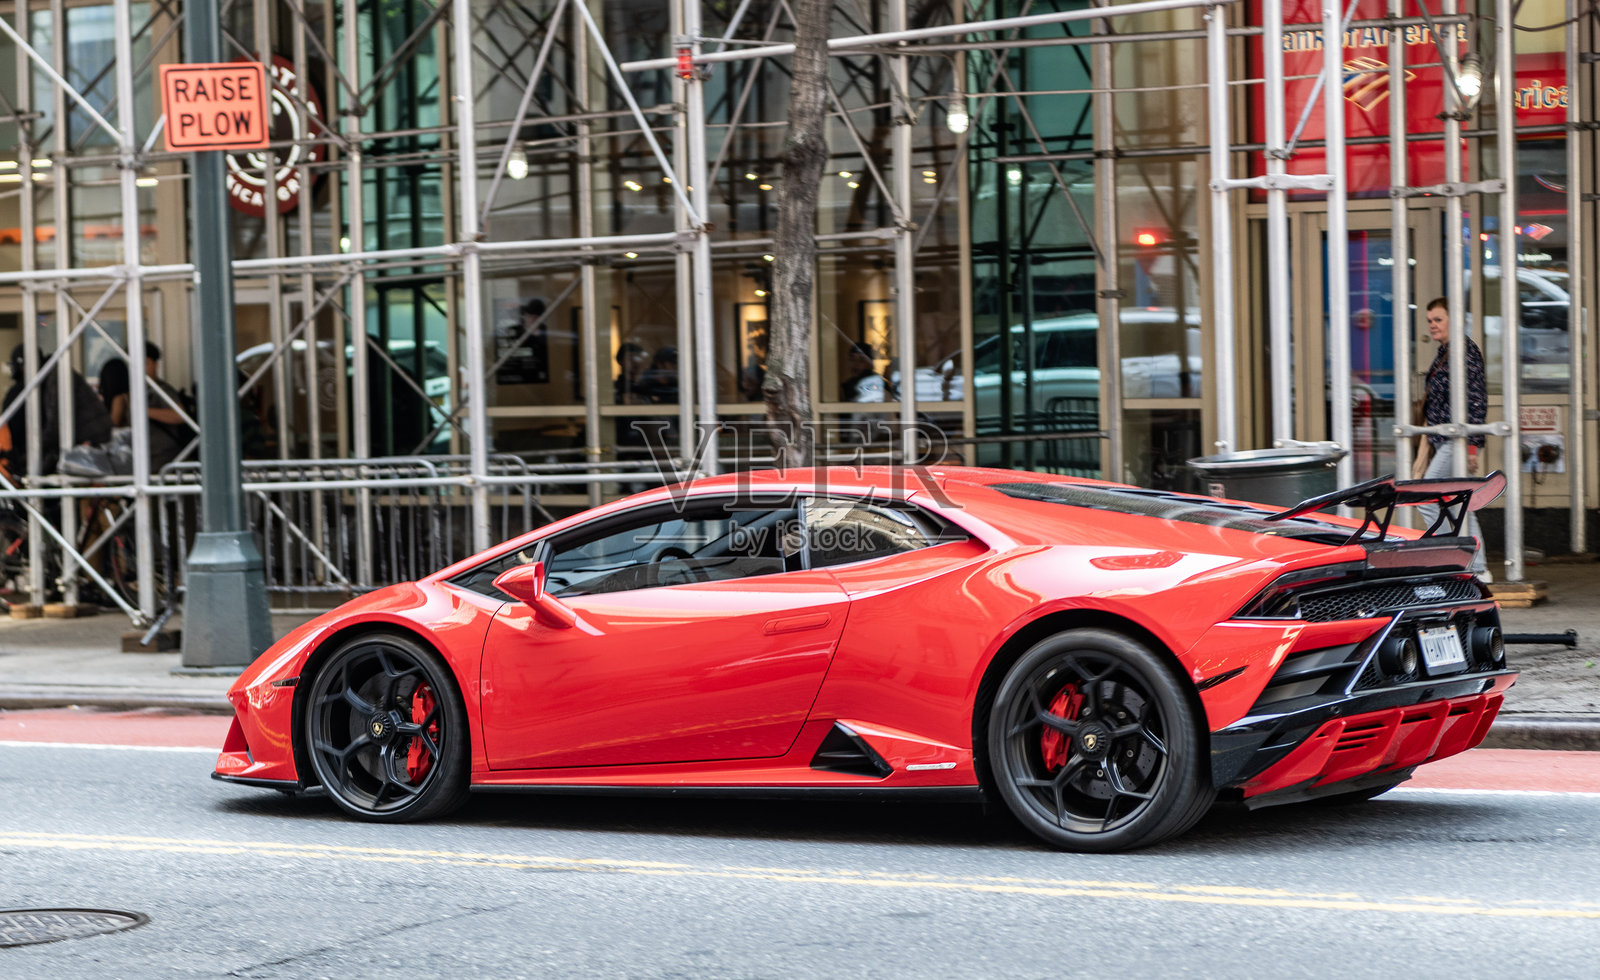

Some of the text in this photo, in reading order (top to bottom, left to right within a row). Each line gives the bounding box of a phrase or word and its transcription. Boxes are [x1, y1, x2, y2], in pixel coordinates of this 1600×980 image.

[1282, 30, 1324, 52] ank
[174, 76, 253, 103] RAISE
[179, 109, 252, 137] PLOW
